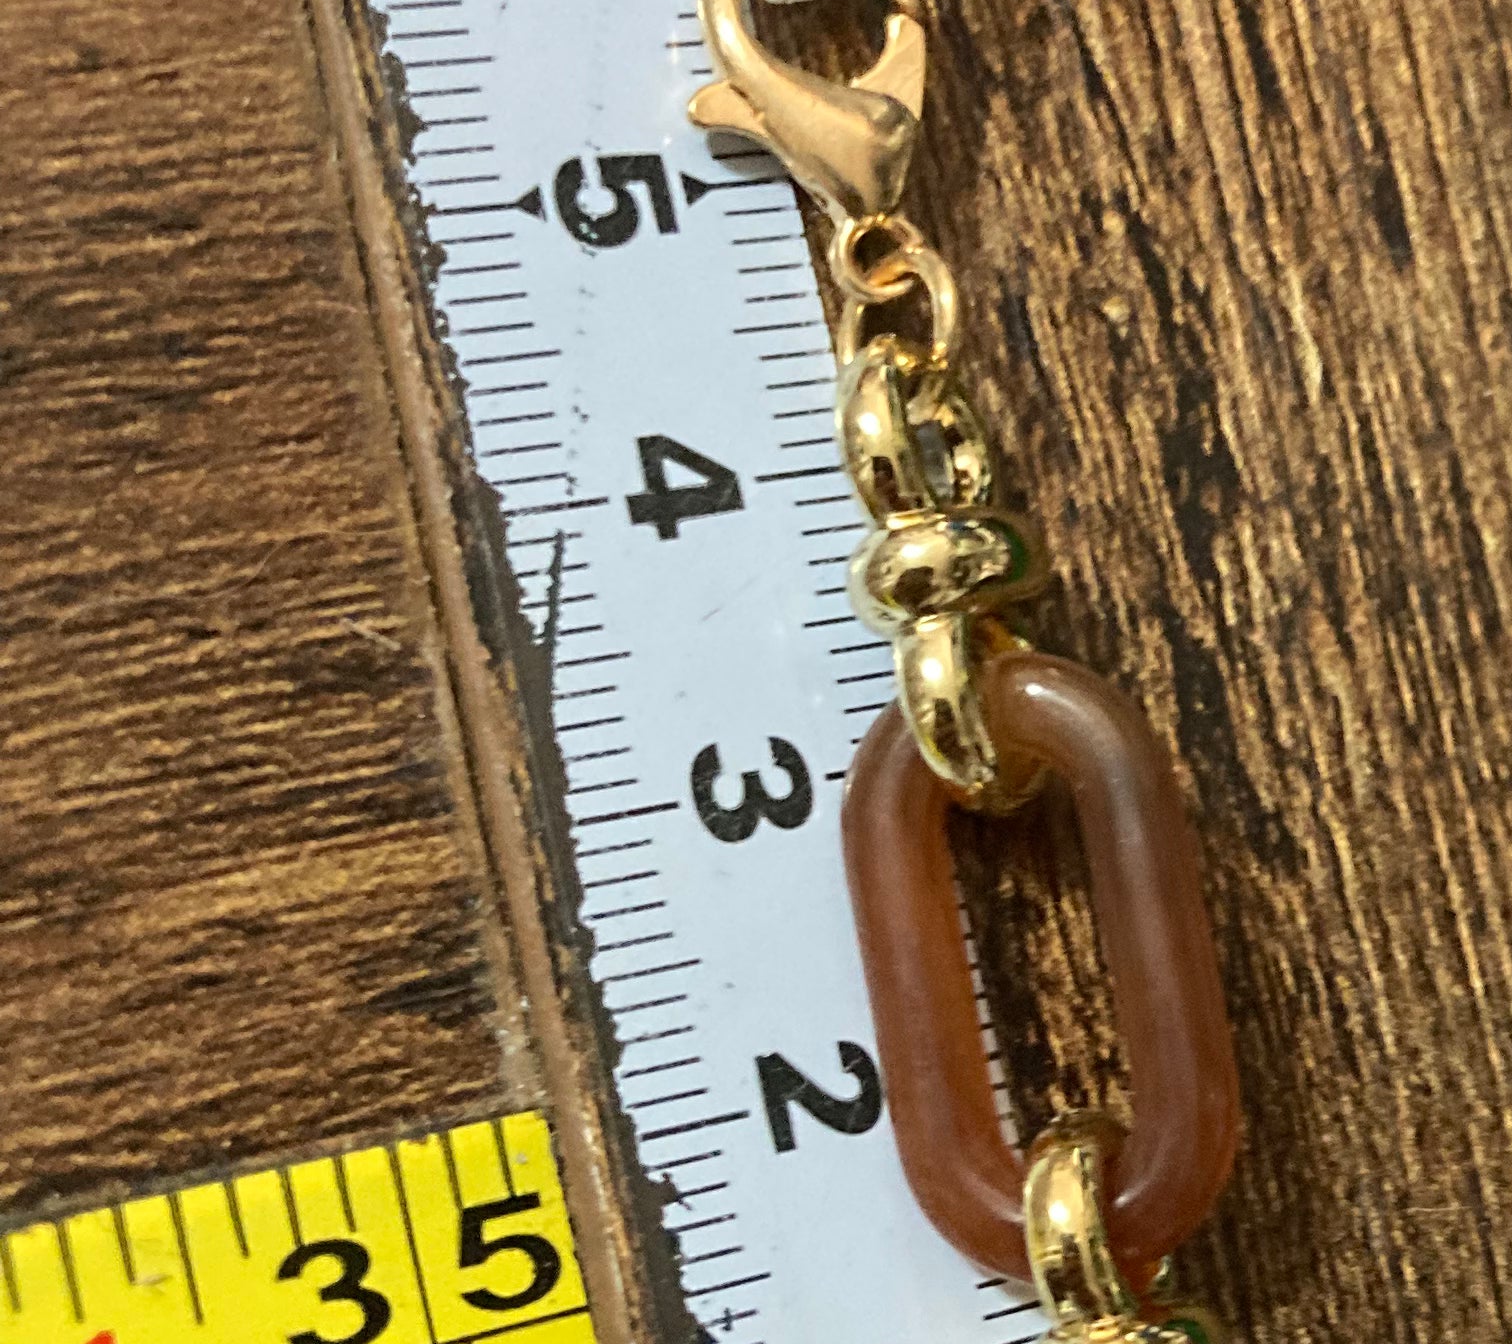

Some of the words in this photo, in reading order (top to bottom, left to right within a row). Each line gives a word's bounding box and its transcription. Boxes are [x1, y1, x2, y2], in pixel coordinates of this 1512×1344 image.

[553, 153, 680, 248] 5
[625, 434, 745, 540] 4
[690, 736, 814, 843] 3
[753, 1041, 884, 1153] 2
